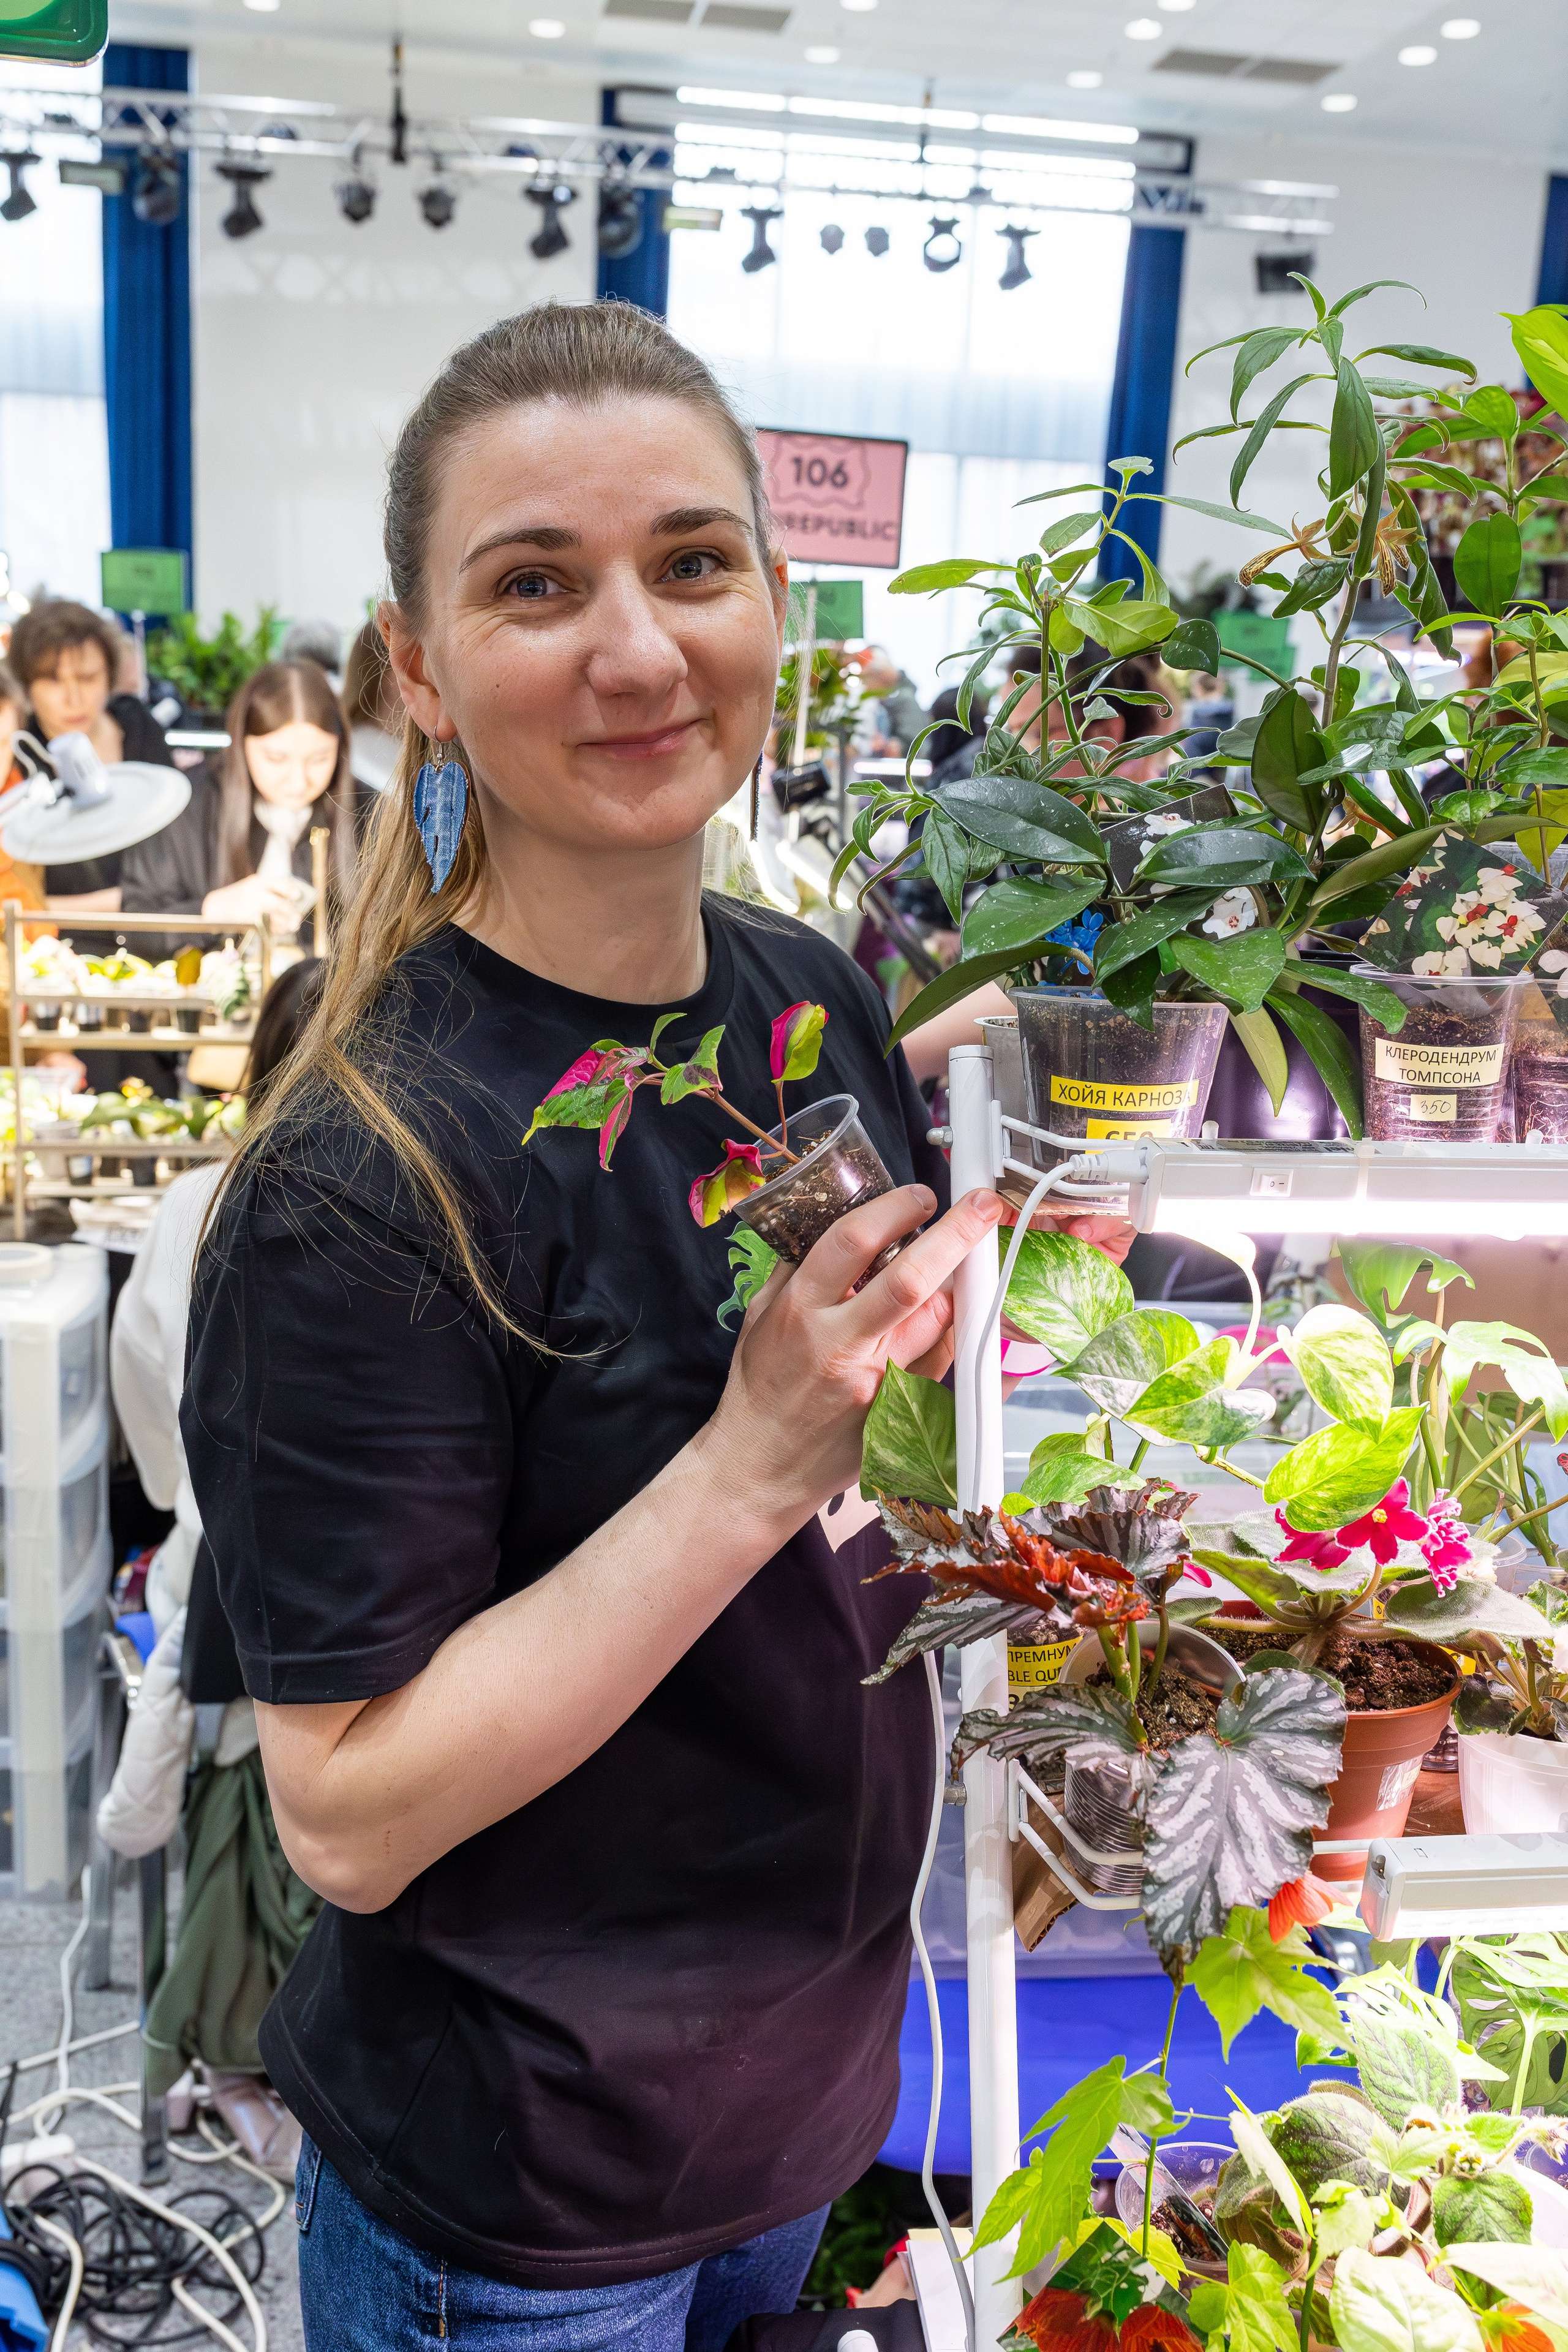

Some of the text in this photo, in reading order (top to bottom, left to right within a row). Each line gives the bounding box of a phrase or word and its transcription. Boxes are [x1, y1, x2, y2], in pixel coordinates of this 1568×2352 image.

[791, 454, 850, 488] 106
[777, 513, 897, 541] REPUBLIC
[1385, 1045, 1496, 1066] КЛЕРОДЕНДРУМ
[1399, 1068, 1481, 1084] ТОМПСОНА
[1058, 1084, 1191, 1107] ХОЙЯ КАРНОЗА
[1420, 1099, 1452, 1115] 350
